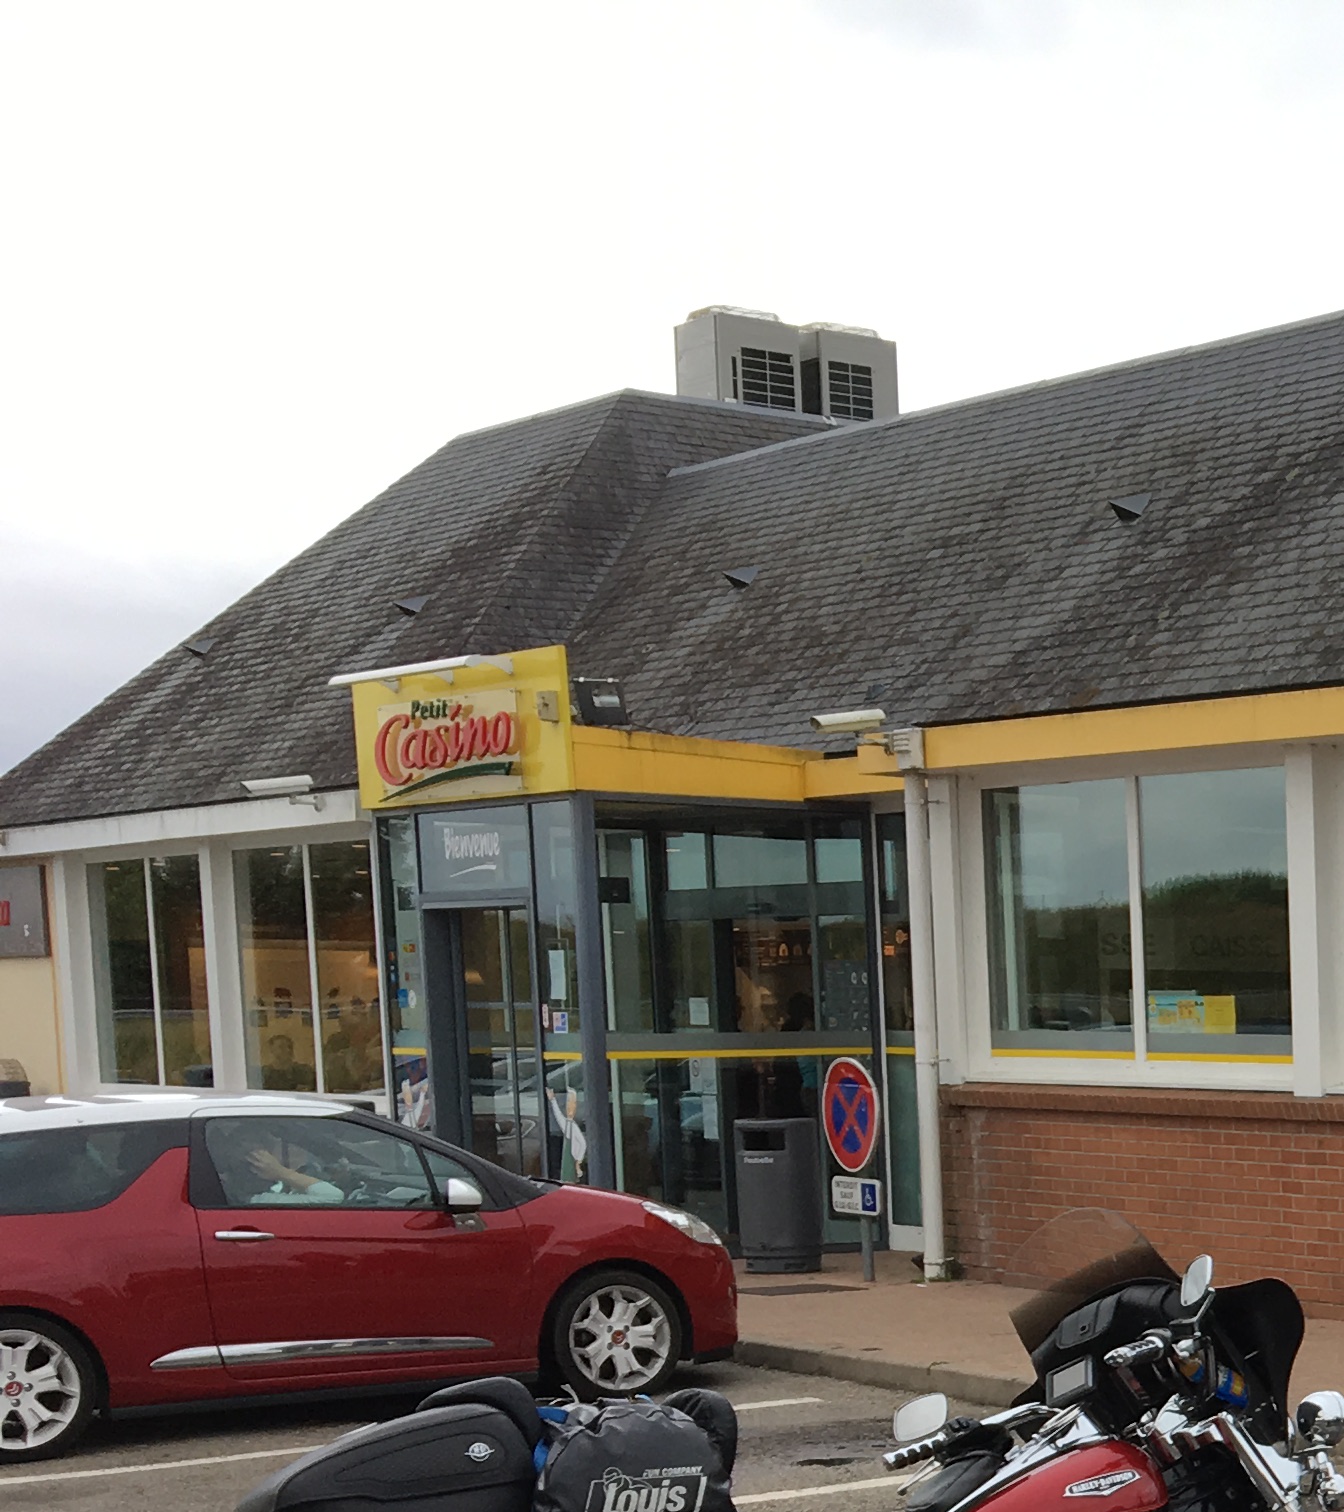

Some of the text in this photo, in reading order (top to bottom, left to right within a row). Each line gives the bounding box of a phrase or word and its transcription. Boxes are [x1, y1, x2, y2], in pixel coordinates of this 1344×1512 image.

[411, 699, 449, 720] Petit
[375, 704, 512, 786] Casino
[443, 828, 500, 859] Bienvenue
[662, 1466, 703, 1477] COMPANY
